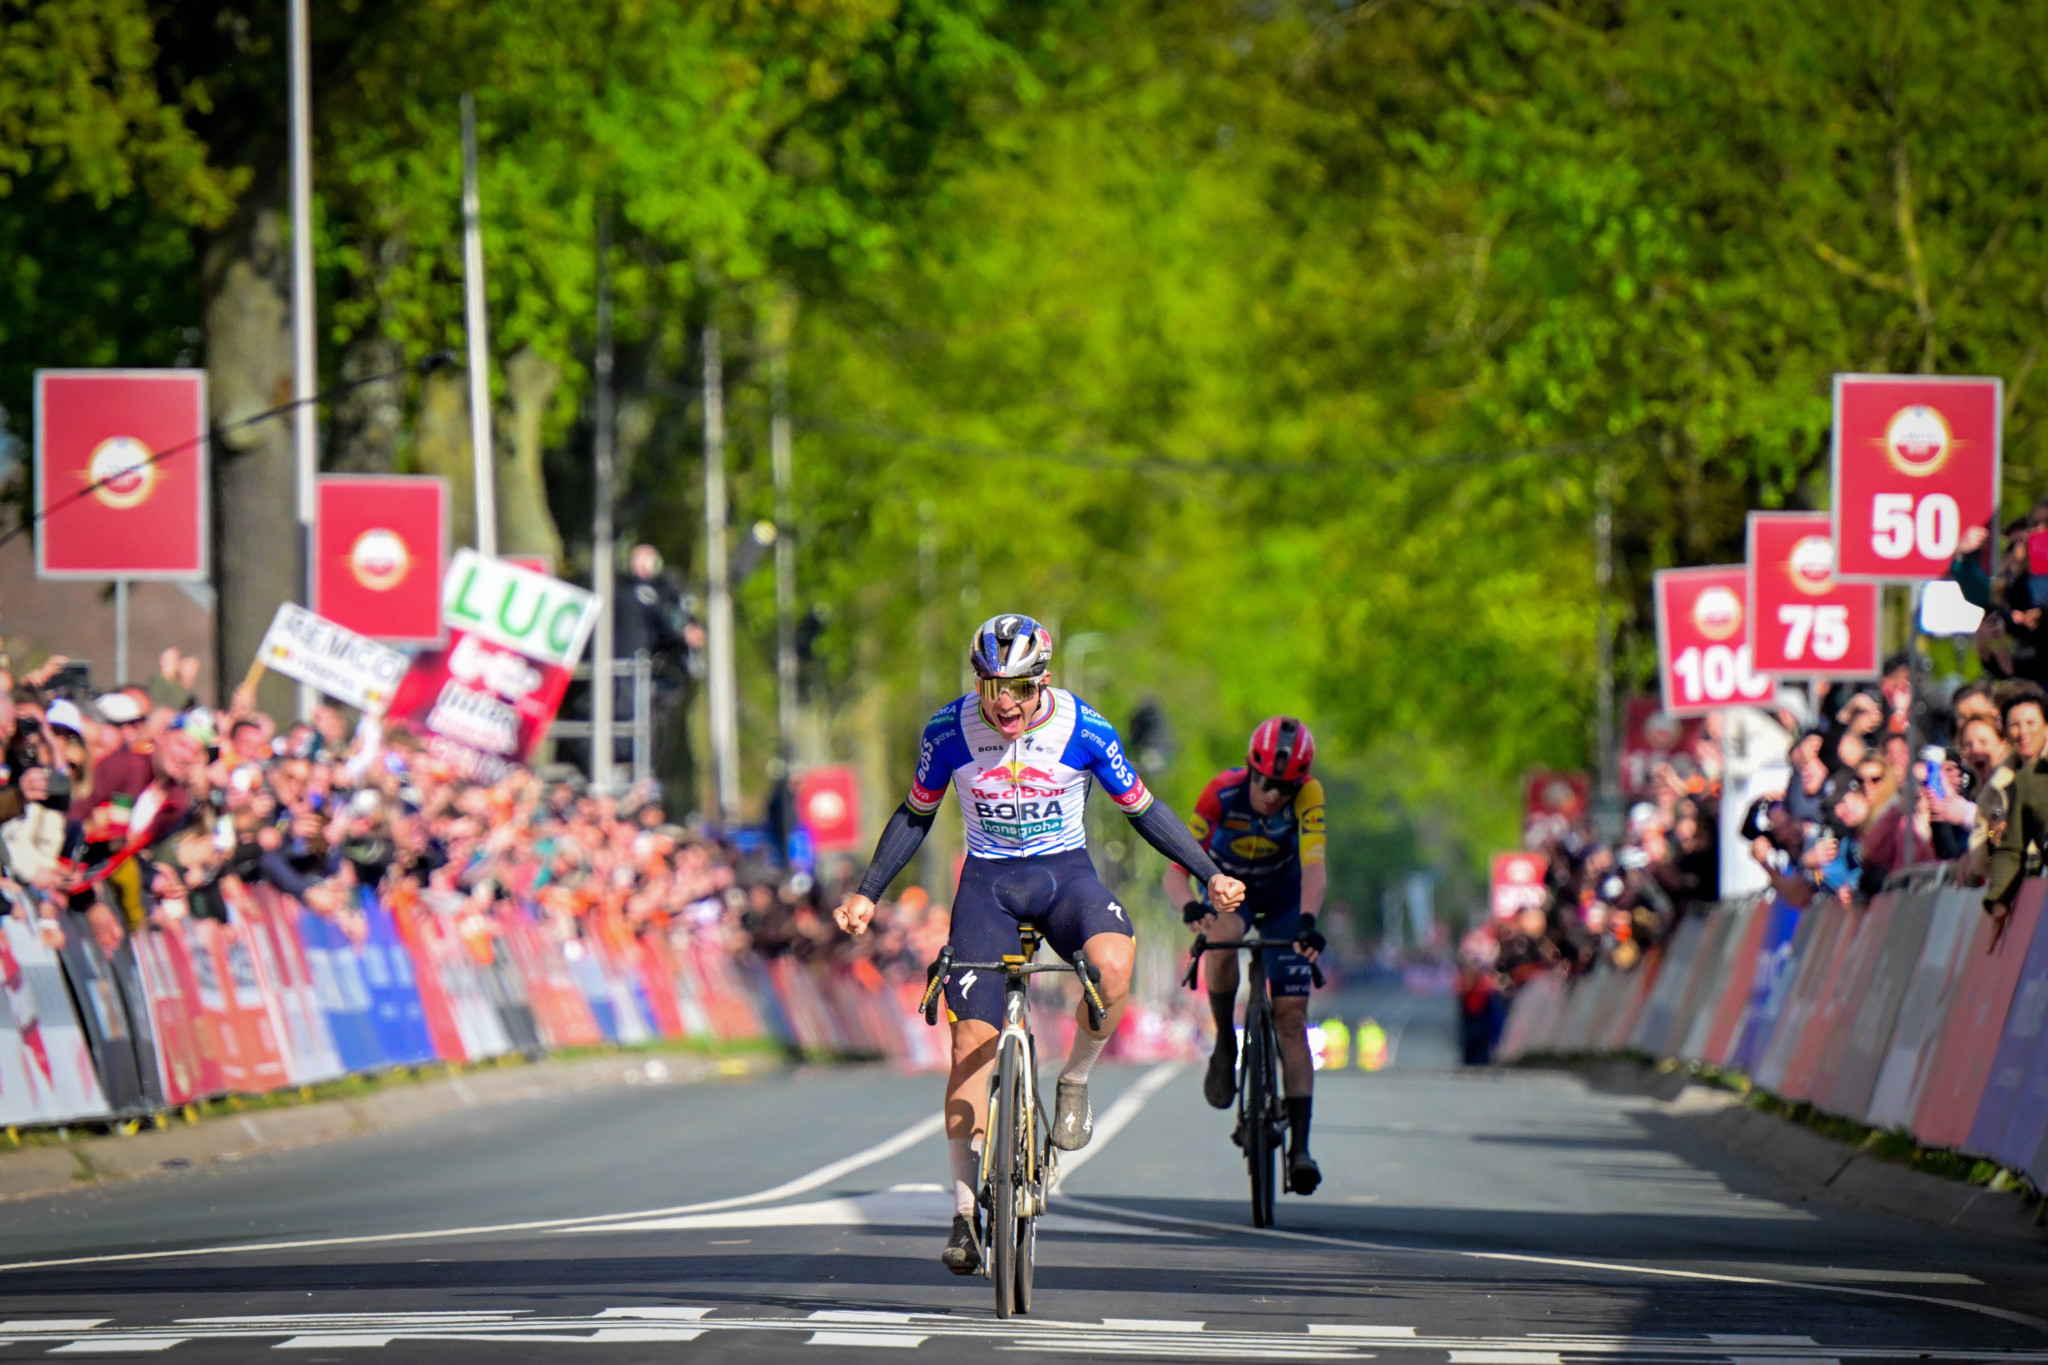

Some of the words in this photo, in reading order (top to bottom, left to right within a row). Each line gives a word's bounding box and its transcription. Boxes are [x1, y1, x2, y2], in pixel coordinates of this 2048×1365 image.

[1872, 493, 1960, 560] 50
[1778, 604, 1850, 661] 75
[917, 737, 934, 784] BOSS
[978, 745, 1004, 753] BOSS
[1105, 740, 1135, 787] BOSS
[971, 784, 1017, 800] Red
[975, 800, 1064, 820] BORA
[983, 821, 1061, 838] hansgrohe
